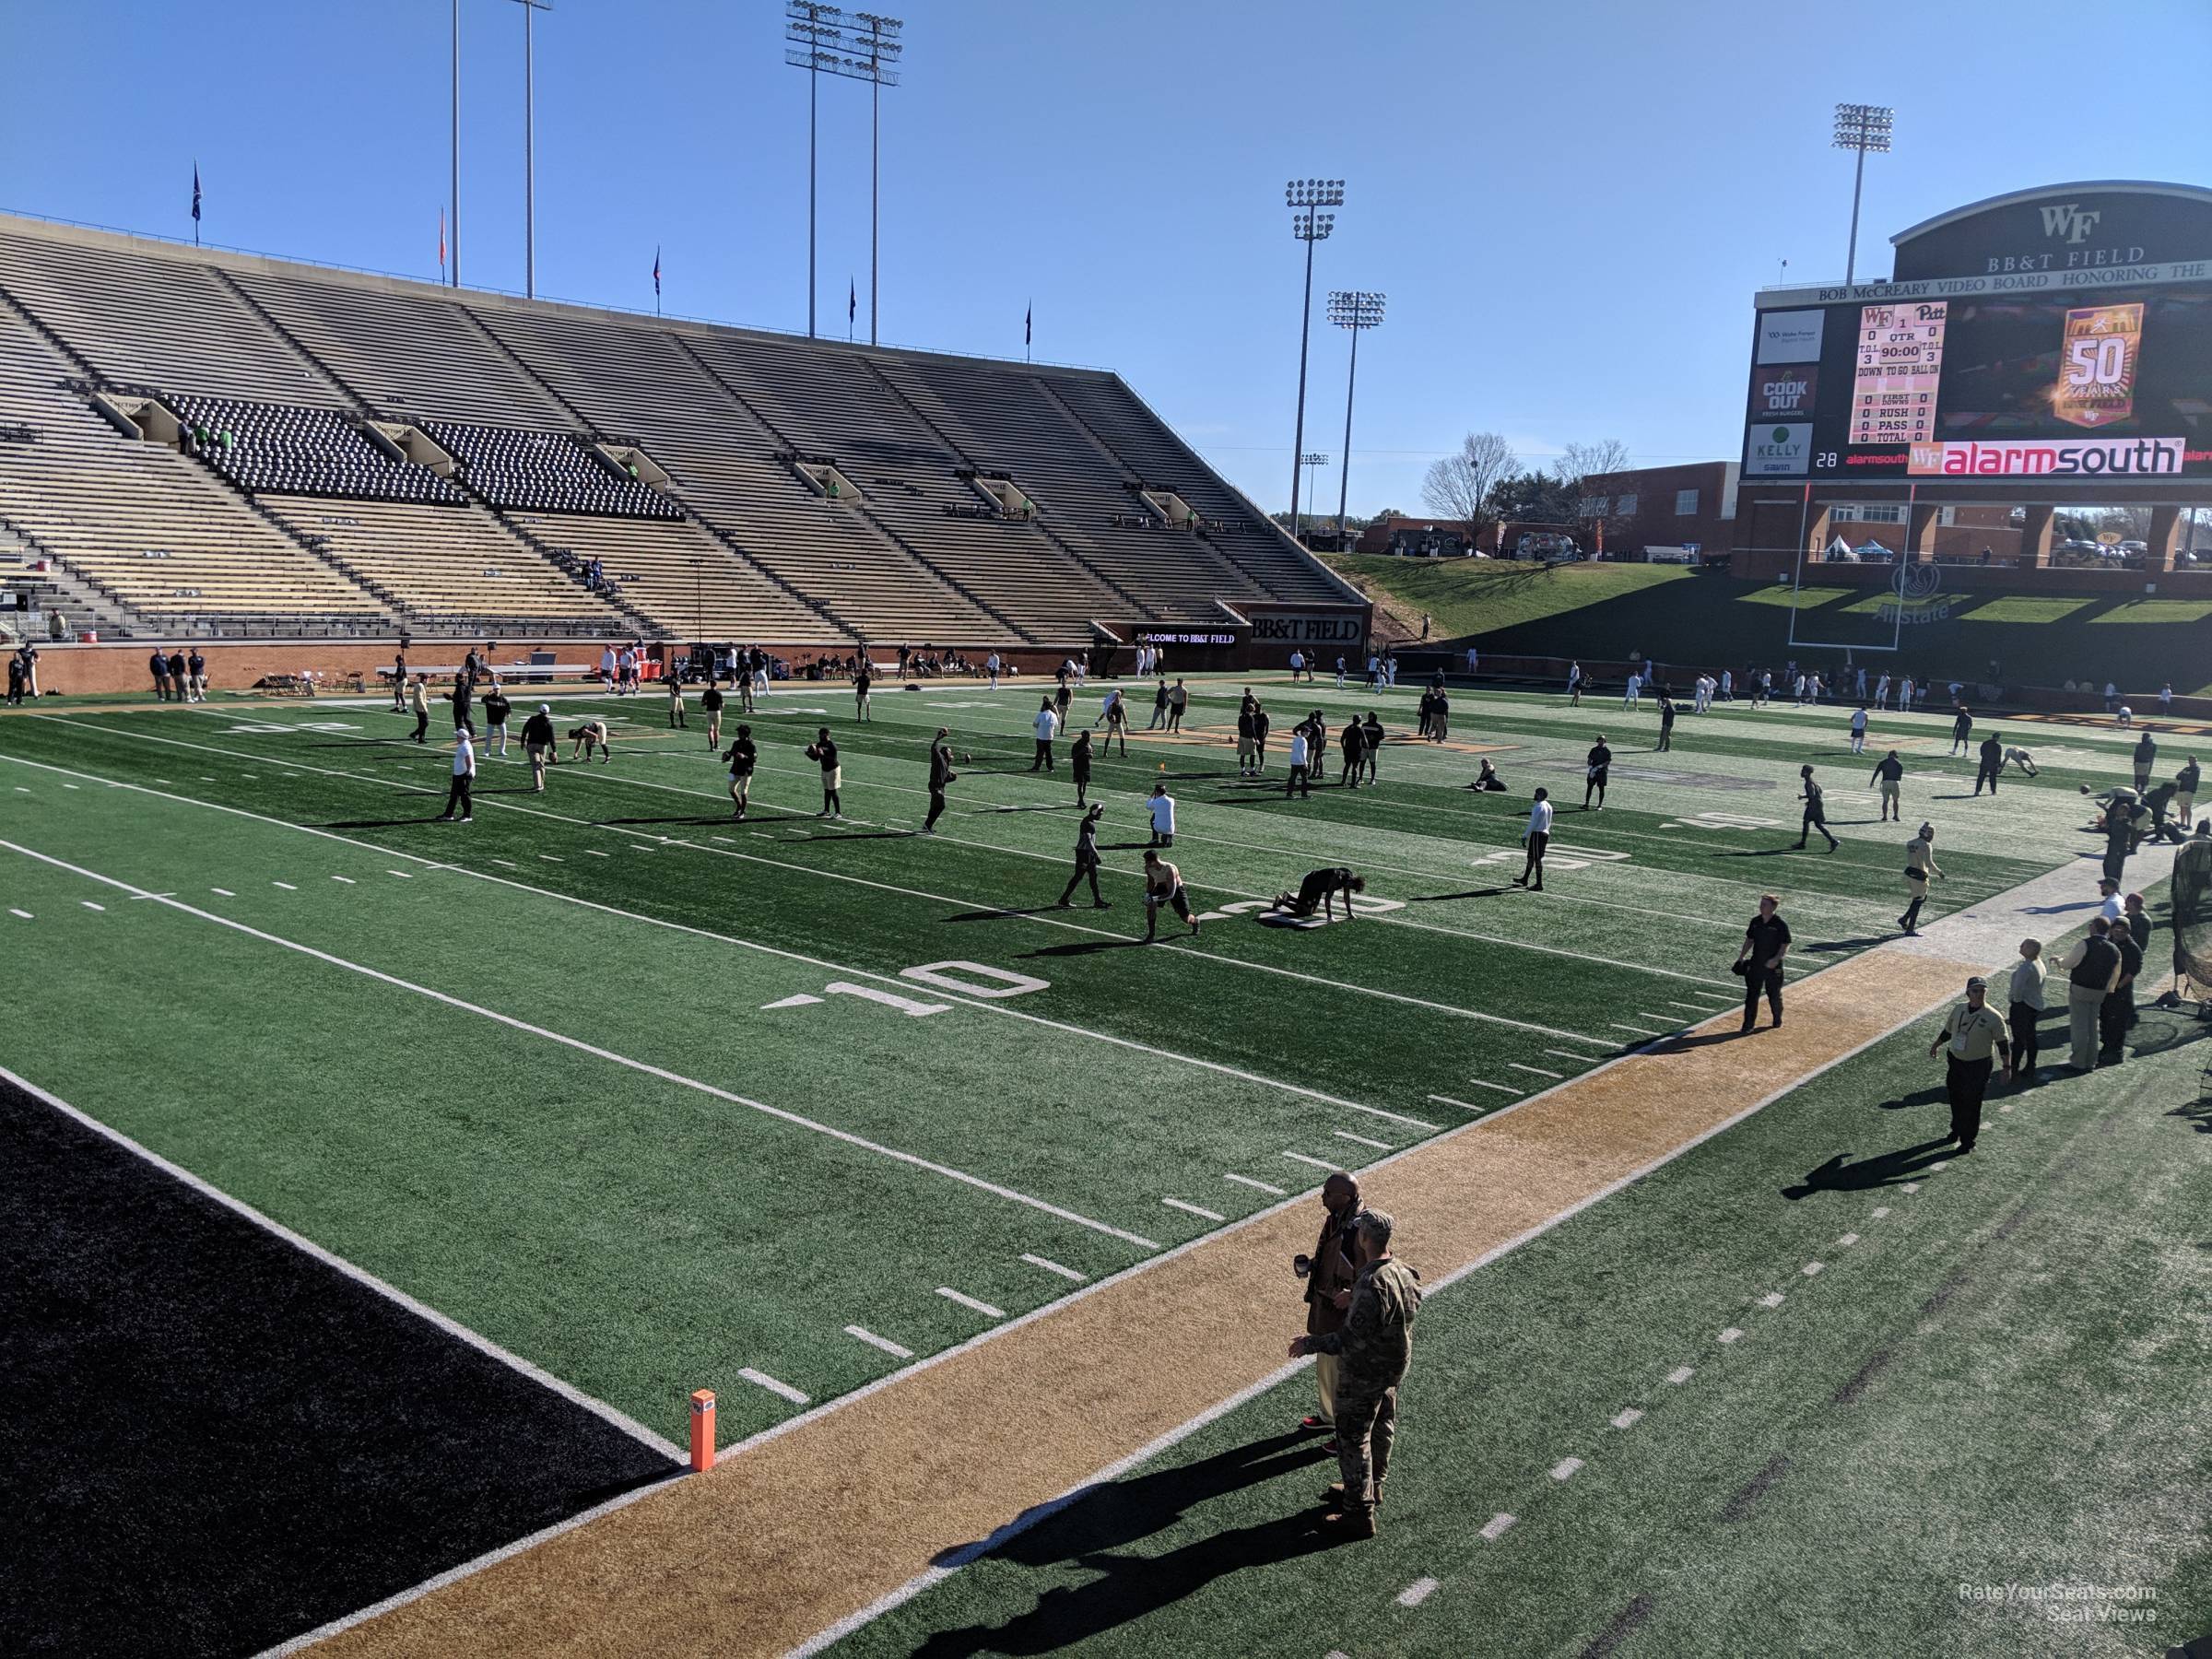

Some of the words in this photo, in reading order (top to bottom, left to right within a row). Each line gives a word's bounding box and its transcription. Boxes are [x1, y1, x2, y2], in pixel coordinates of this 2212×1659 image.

[2039, 203, 2100, 244] WF
[1987, 254, 2053, 273] BB&T
[2067, 247, 2145, 267] FIELD
[1819, 288, 1847, 300] BOB
[1853, 283, 1930, 299] McCREARY
[1938, 278, 1986, 293] VIDEO
[1993, 276, 2048, 289] BOARD
[2063, 266, 2158, 286] HONORING
[2171, 263, 2206, 278] THE
[1864, 307, 1892, 327] WF
[1900, 319, 1906, 328] 1
[1867, 331, 1877, 340] 0
[1928, 327, 1936, 336] 0
[1889, 333, 1915, 342] QTR
[1881, 346, 1919, 357] 90:00
[1926, 352, 1935, 361] 3
[1864, 355, 1872, 364] 3
[2069, 337, 2126, 385] 50
[1858, 367, 1883, 377] DOWN
[1886, 367, 1897, 376] TO
[1911, 365, 1928, 375] BALL
[1763, 381, 1807, 395] COOK
[2070, 385, 2122, 394] YEARS
[1768, 395, 1801, 409] OUT
[1865, 395, 1872, 405] 0
[1920, 394, 1927, 403] 0
[1863, 408, 1870, 418] 0
[1879, 408, 1909, 418] RUSH
[1918, 407, 1925, 417] 0
[1862, 421, 1869, 430] 0
[1877, 421, 1907, 429] PASS
[1916, 420, 1924, 429] 0
[1861, 433, 1868, 441] 0
[1877, 432, 1907, 442] TOTAL
[1914, 432, 1923, 441] 0
[1757, 443, 1801, 457] KELLY
[1816, 453, 1837, 467] 28
[1846, 453, 1908, 465] alarmsouth
[1944, 439, 2176, 474] alarmsouth
[1873, 604, 1949, 625] Allstate
[1252, 618, 1303, 639] BB&T
[1304, 619, 1359, 641] FIELD
[1147, 633, 1177, 642] ELCOME
[1179, 634, 1189, 642] TO
[1190, 634, 1208, 643] BB&T
[1210, 634, 1235, 643] FIELD
[1675, 812, 1784, 830] 40
[825, 960, 1052, 1016] 10
